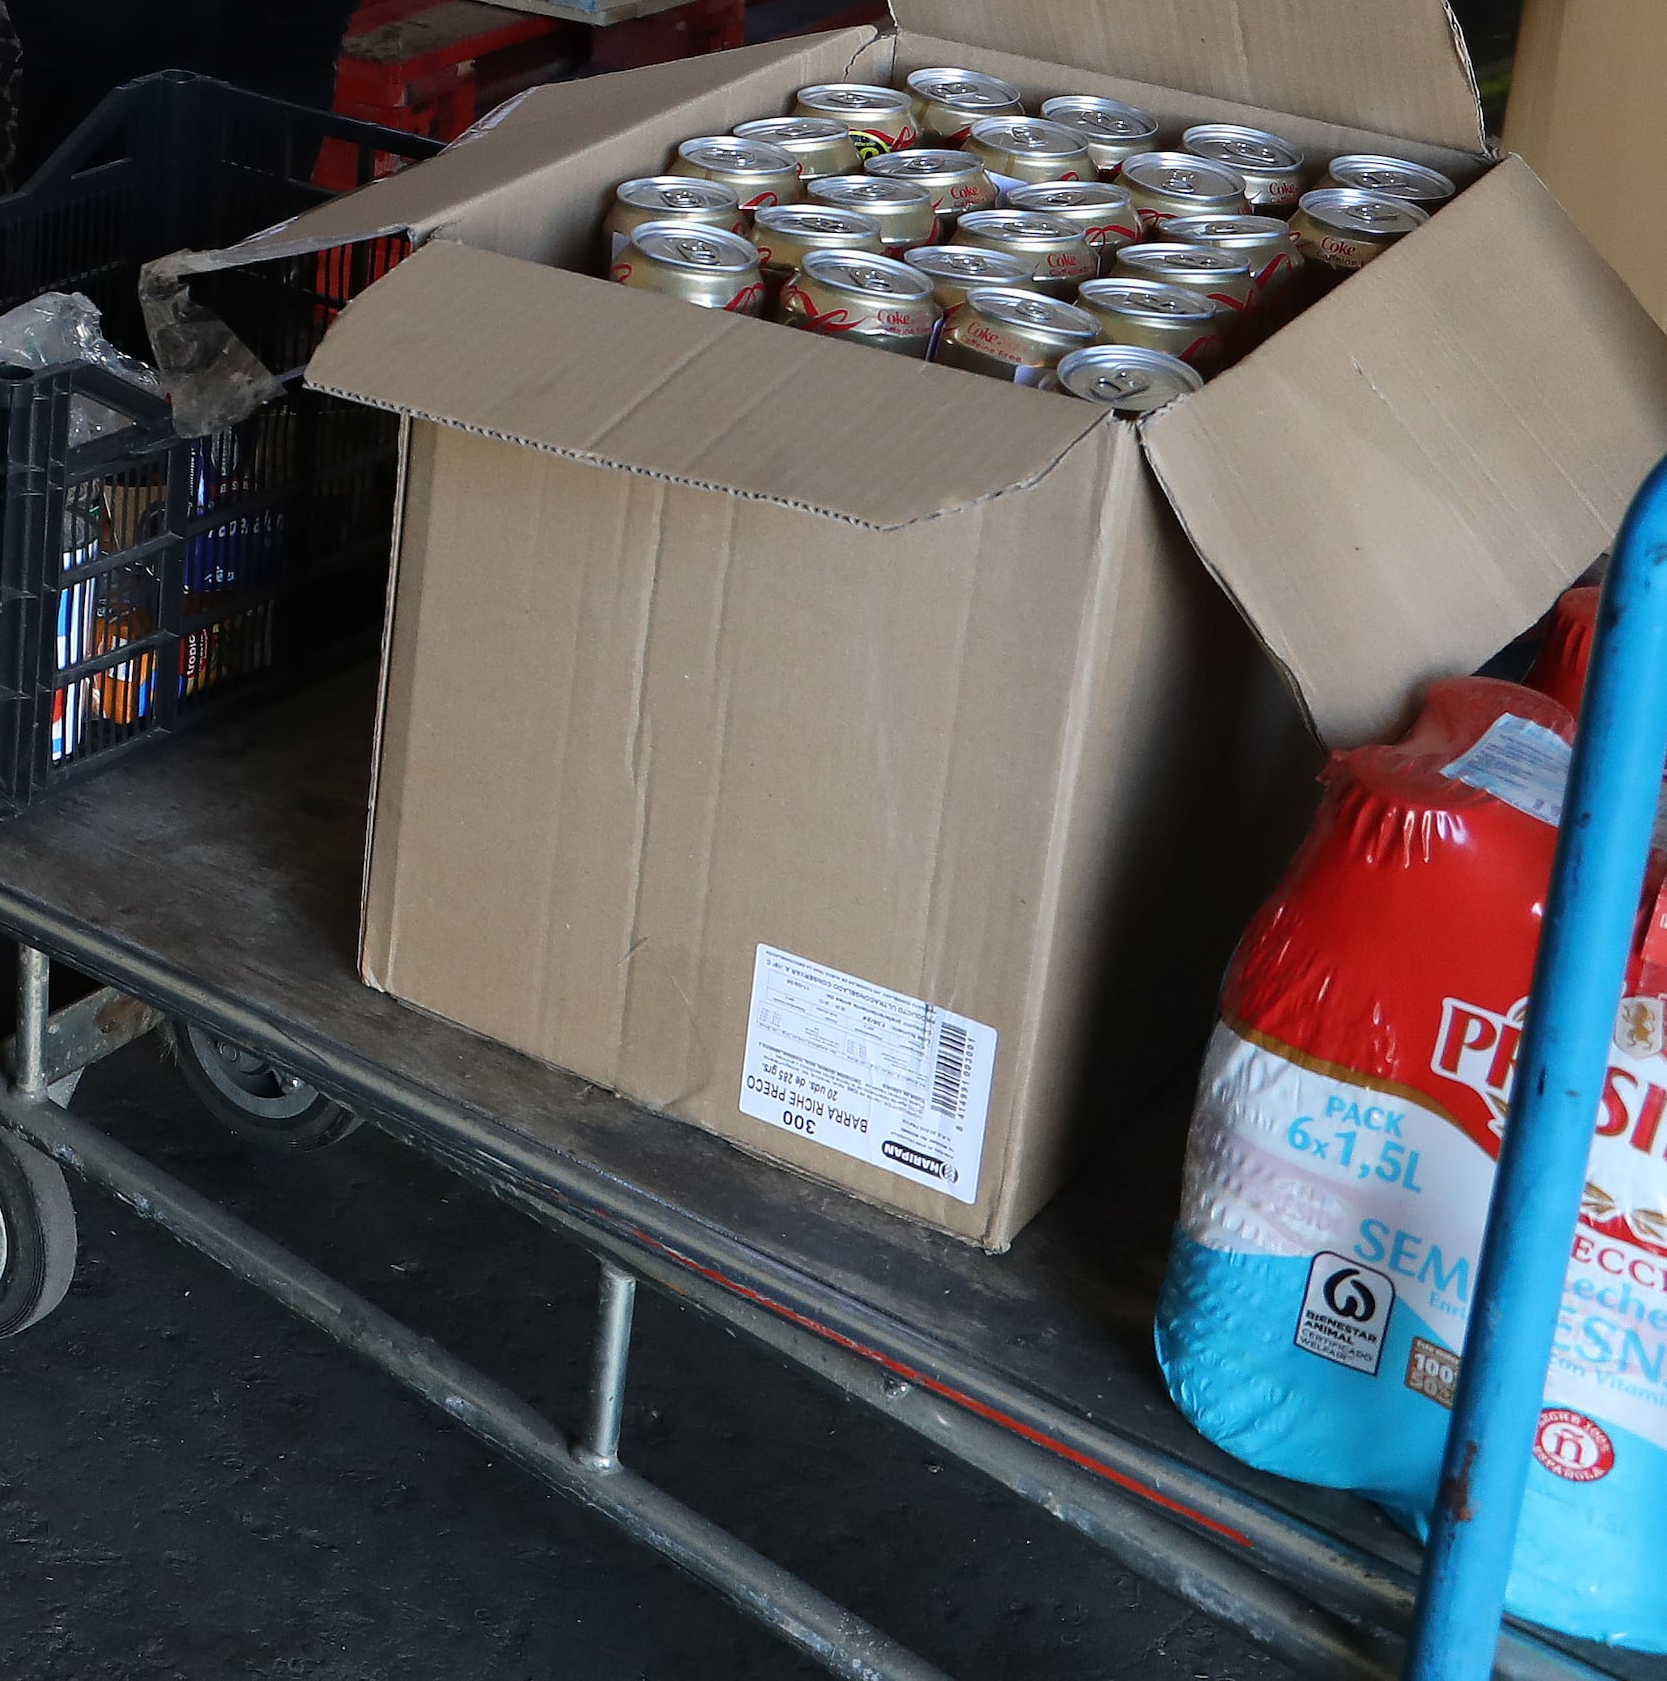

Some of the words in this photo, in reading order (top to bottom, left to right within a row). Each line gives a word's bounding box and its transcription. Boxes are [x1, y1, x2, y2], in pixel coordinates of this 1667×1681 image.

[950, 185, 979, 199] Coke
[1270, 182, 1295, 196] Coke
[1322, 235, 1356, 256] Coke
[1047, 254, 1077, 267] Coke
[877, 309, 910, 325] Coke
[967, 321, 999, 342] Coke
[778, 1070, 793, 1084] 285
[795, 1075, 806, 1087] de
[747, 1076, 785, 1102] PRECO
[810, 1081, 825, 1095] uds.
[827, 1088, 837, 1101] 20
[790, 1093, 823, 1115] RICHE
[783, 1110, 816, 1135] 300
[828, 1106, 868, 1133] BARRA
[1325, 1094, 1405, 1137] PACK
[884, 1145, 940, 1174] HARIPAN
[1287, 1116, 1422, 1192] 6x1,5L
[1303, 1319, 1354, 1345] ANIMAL
[1305, 1308, 1378, 1343] BIENESTAR
[1301, 1326, 1374, 1362] CERTIFICADO
